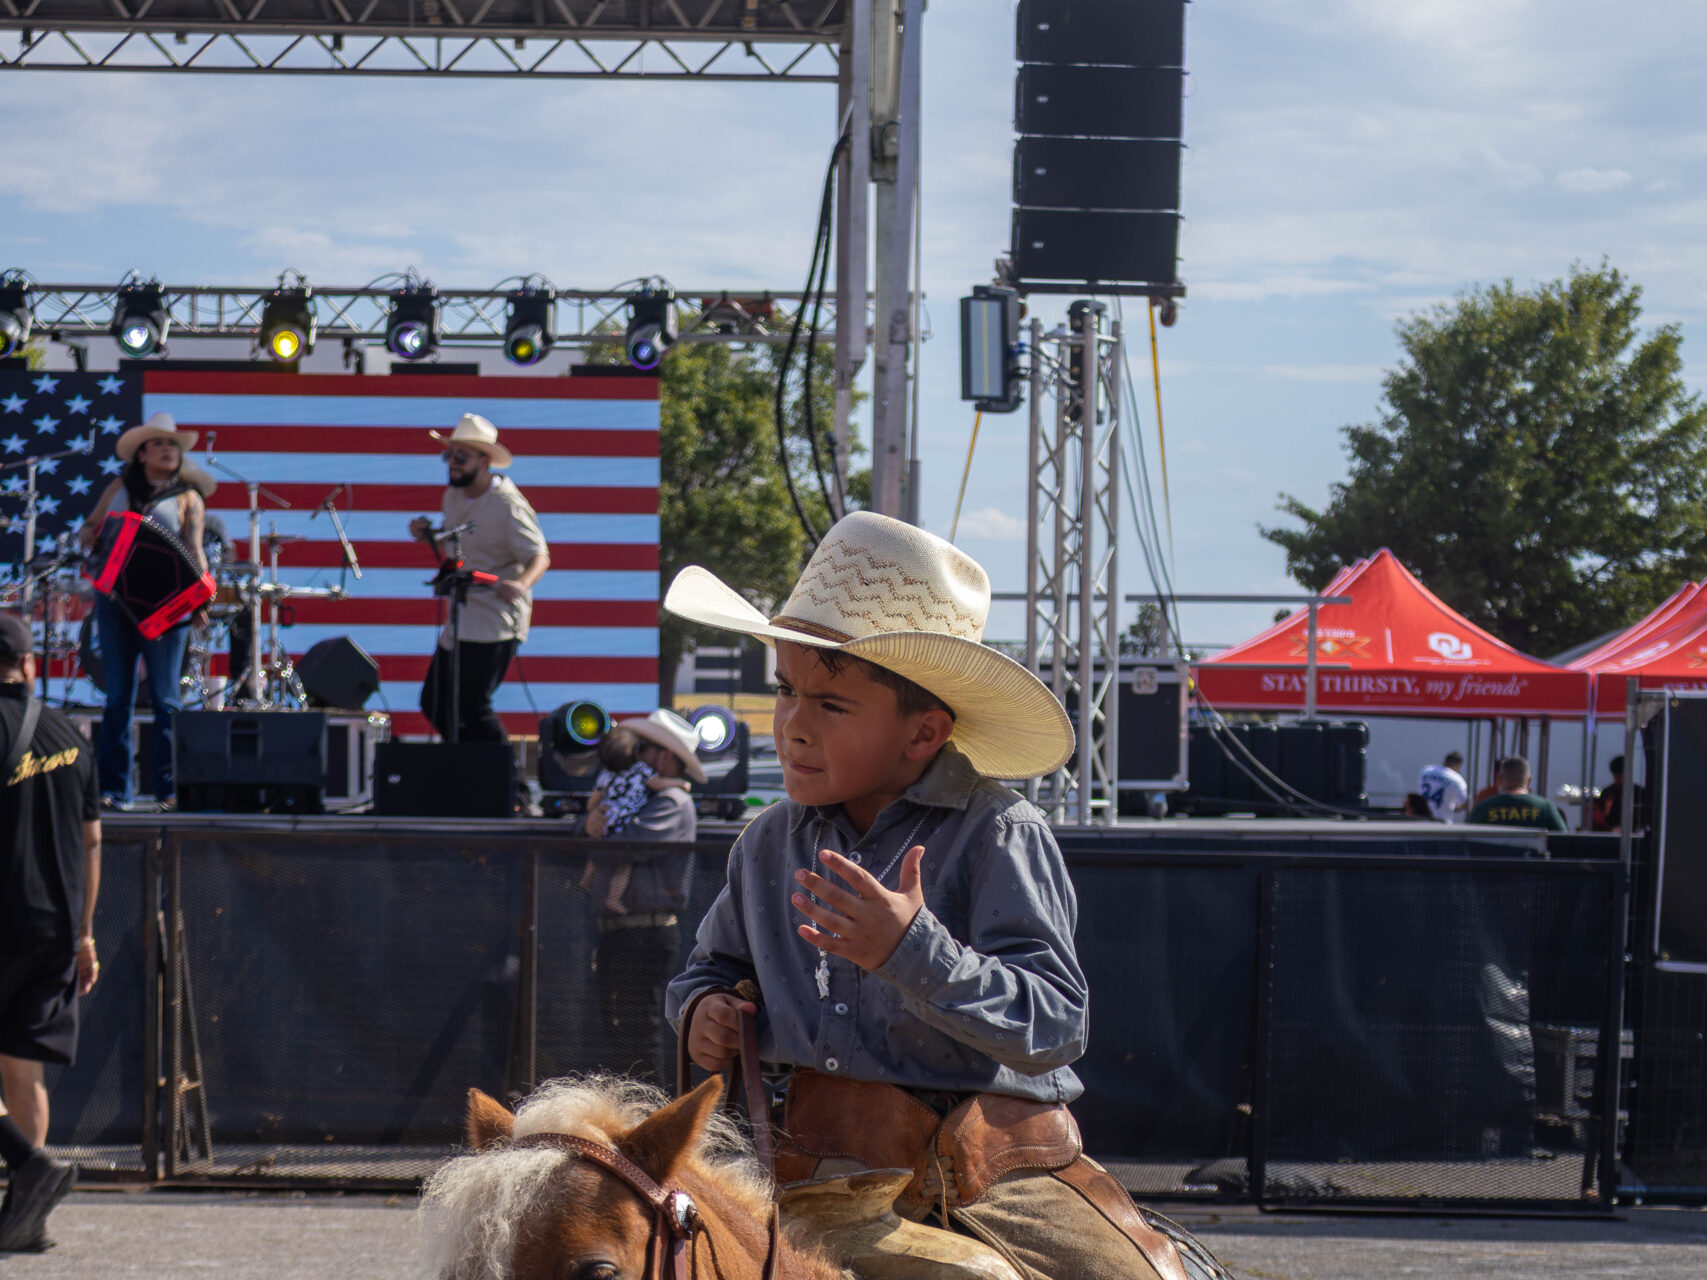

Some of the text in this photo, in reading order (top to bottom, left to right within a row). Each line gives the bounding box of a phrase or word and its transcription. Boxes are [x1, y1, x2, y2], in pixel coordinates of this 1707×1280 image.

[1428, 632, 1473, 660] OU
[1320, 675, 1420, 695] THIRSTY,
[1426, 679, 1454, 700] my
[1488, 806, 1540, 822] STAFF
